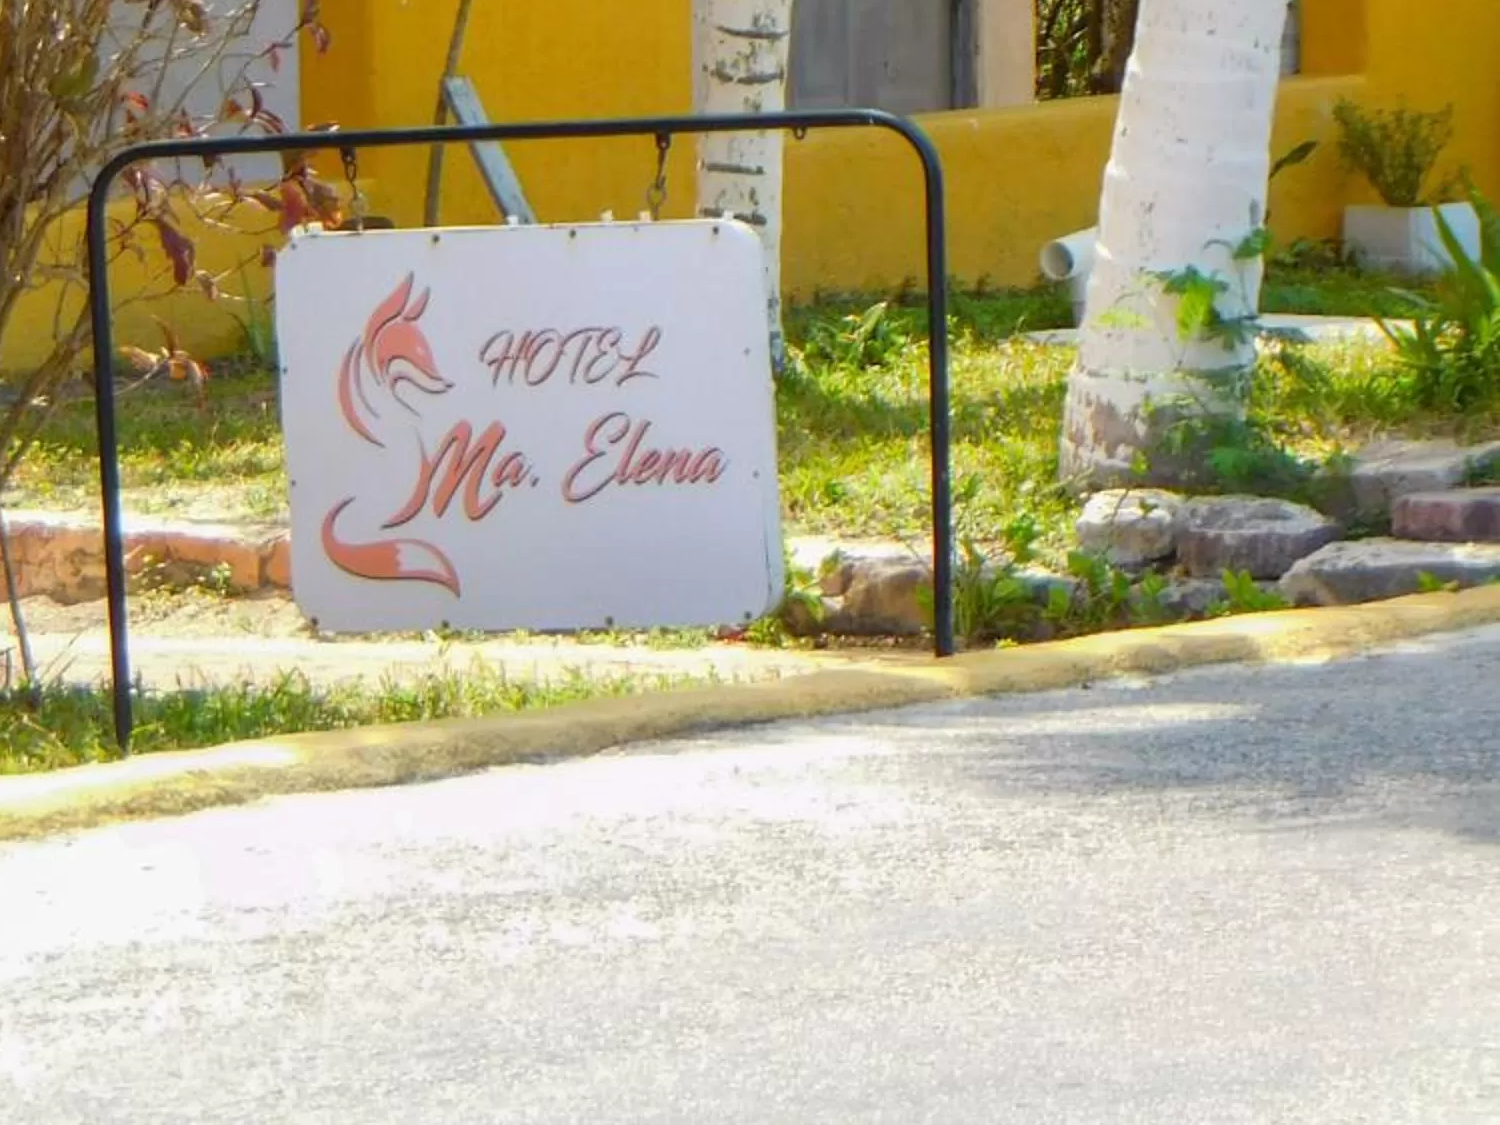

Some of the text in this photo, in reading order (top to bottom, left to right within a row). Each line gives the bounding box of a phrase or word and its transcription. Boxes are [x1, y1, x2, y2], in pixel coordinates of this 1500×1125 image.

[479, 324, 662, 387] HOTEL
[428, 411, 729, 522] Ma. Elena
